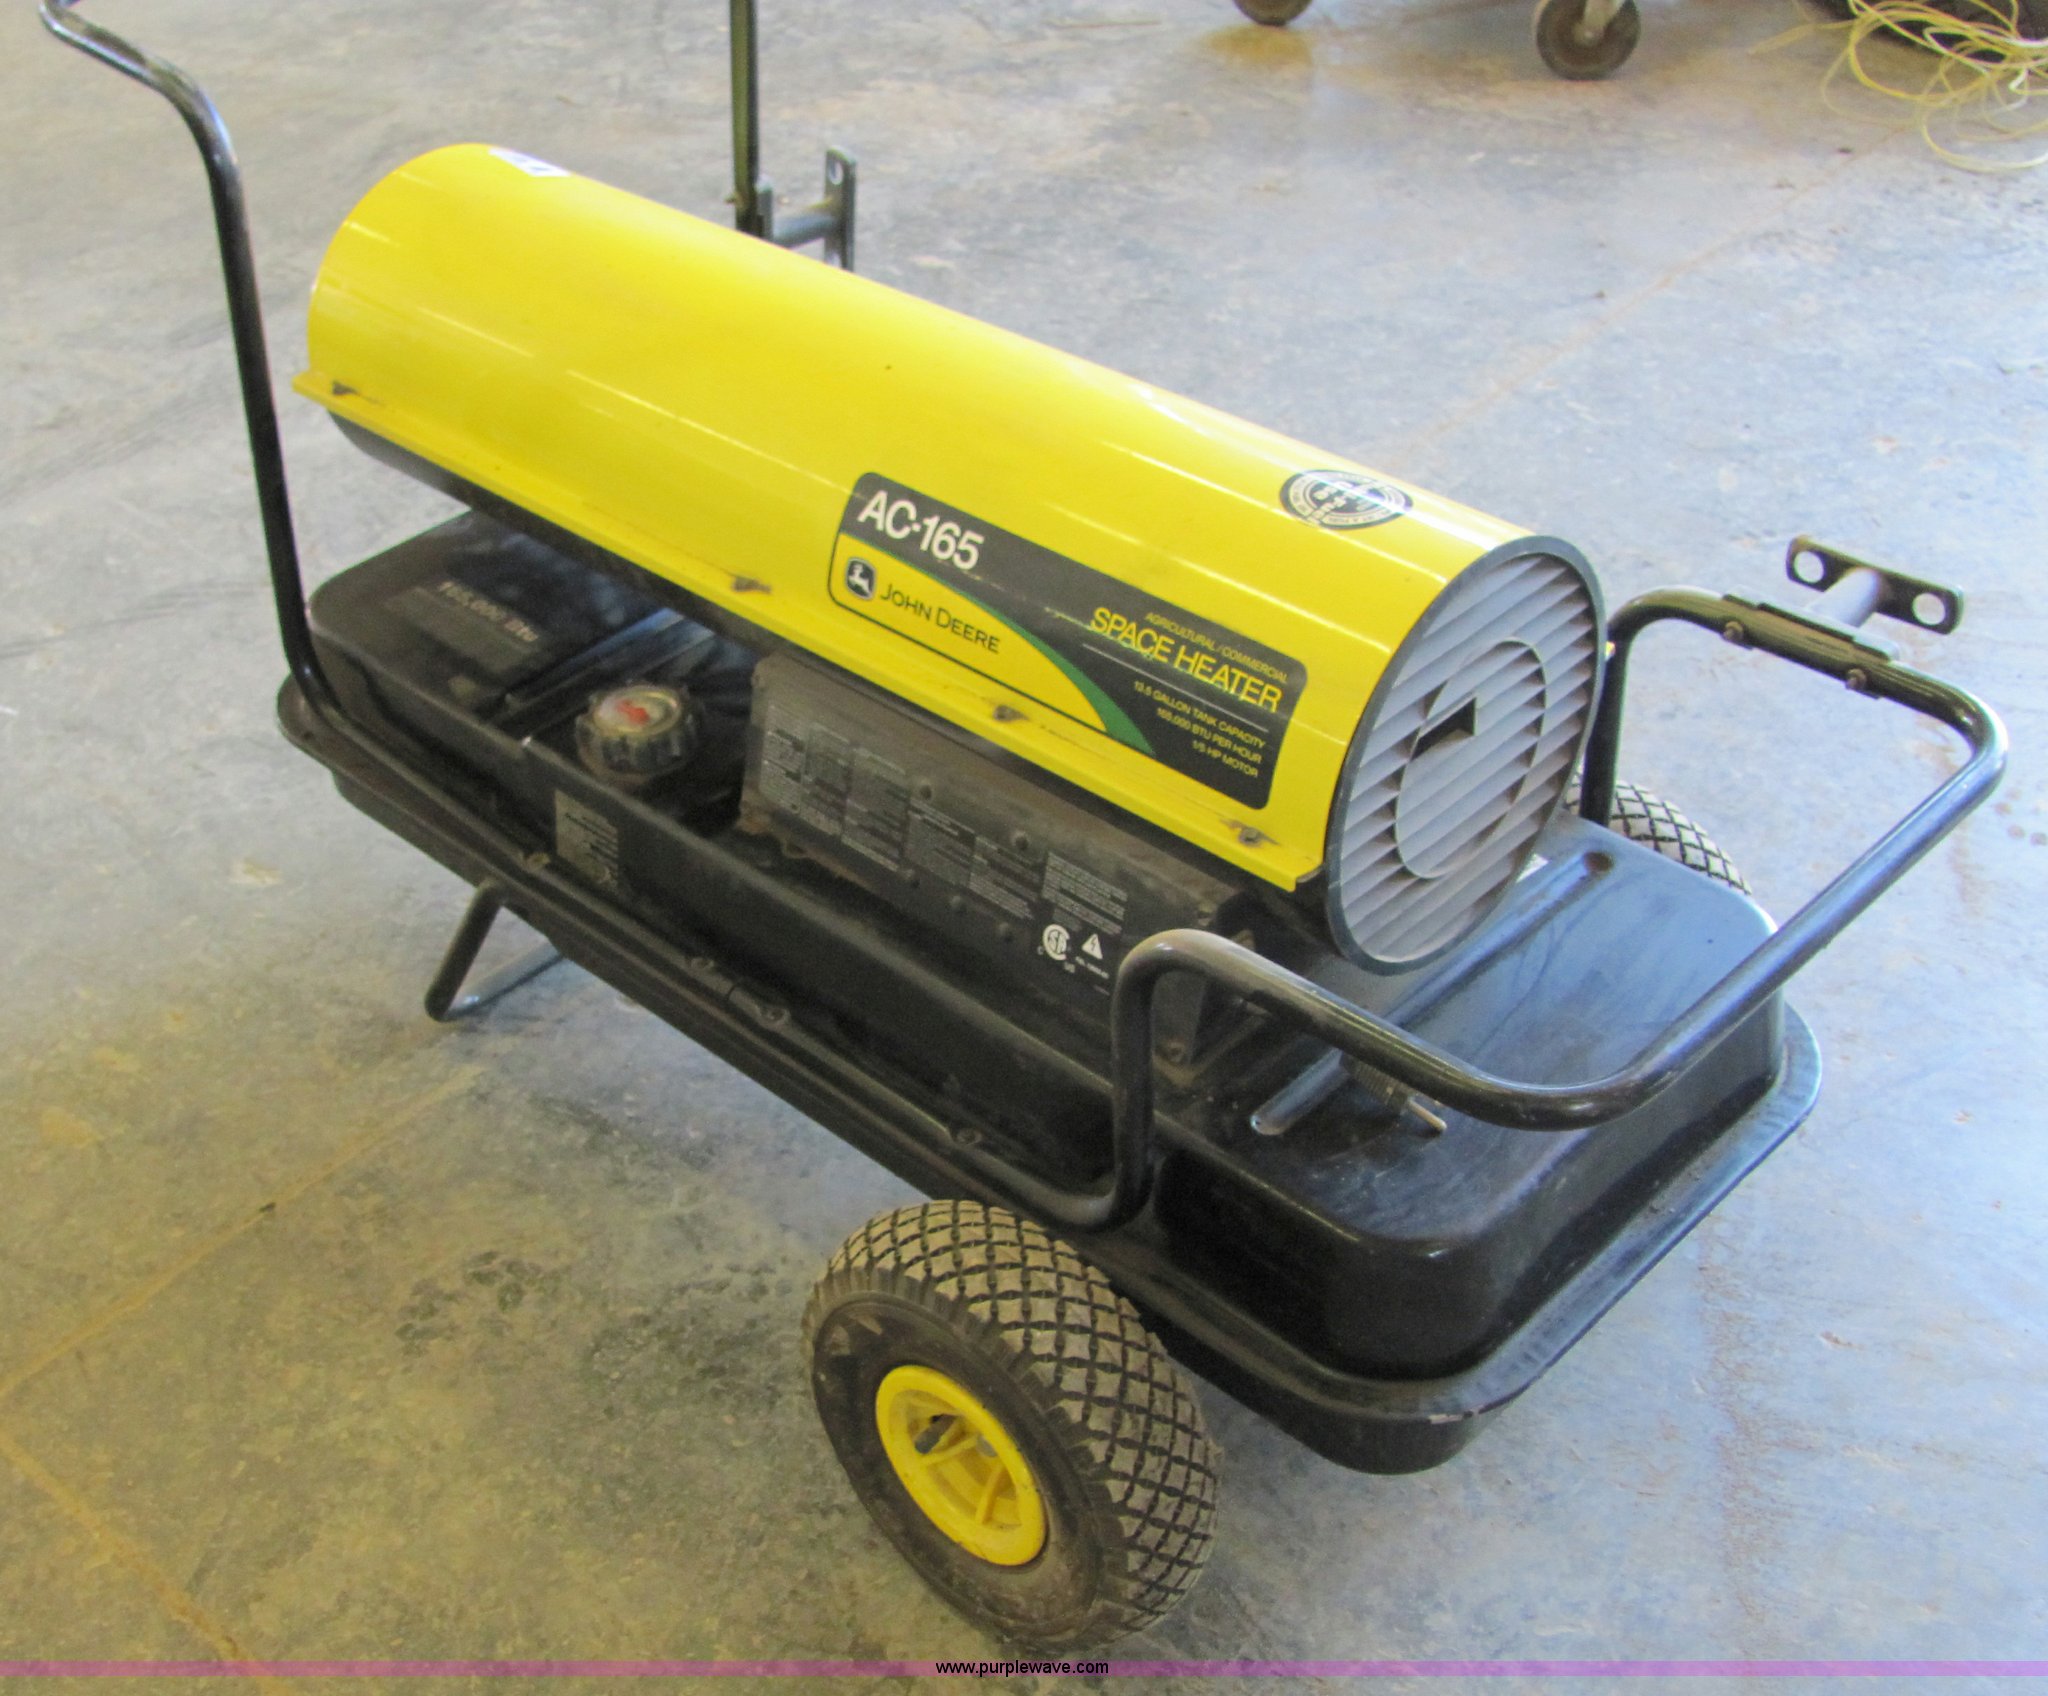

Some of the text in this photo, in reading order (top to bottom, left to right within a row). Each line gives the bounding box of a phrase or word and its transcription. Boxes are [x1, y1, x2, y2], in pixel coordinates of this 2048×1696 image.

[857, 490, 985, 570] AC-165
[880, 584, 1001, 654] JOHN DEERE
[1090, 607, 1282, 713] SPACE HEATER
[1152, 689, 1191, 715] GALLON
[1193, 707, 1218, 728] TANK
[1218, 720, 1267, 749] CAPACITY
[1192, 723, 1212, 741] BTU
[1212, 733, 1233, 751] PER
[1233, 741, 1263, 764] HOUR
[1207, 746, 1222, 760] HP
[1222, 753, 1259, 778] MOTOR
